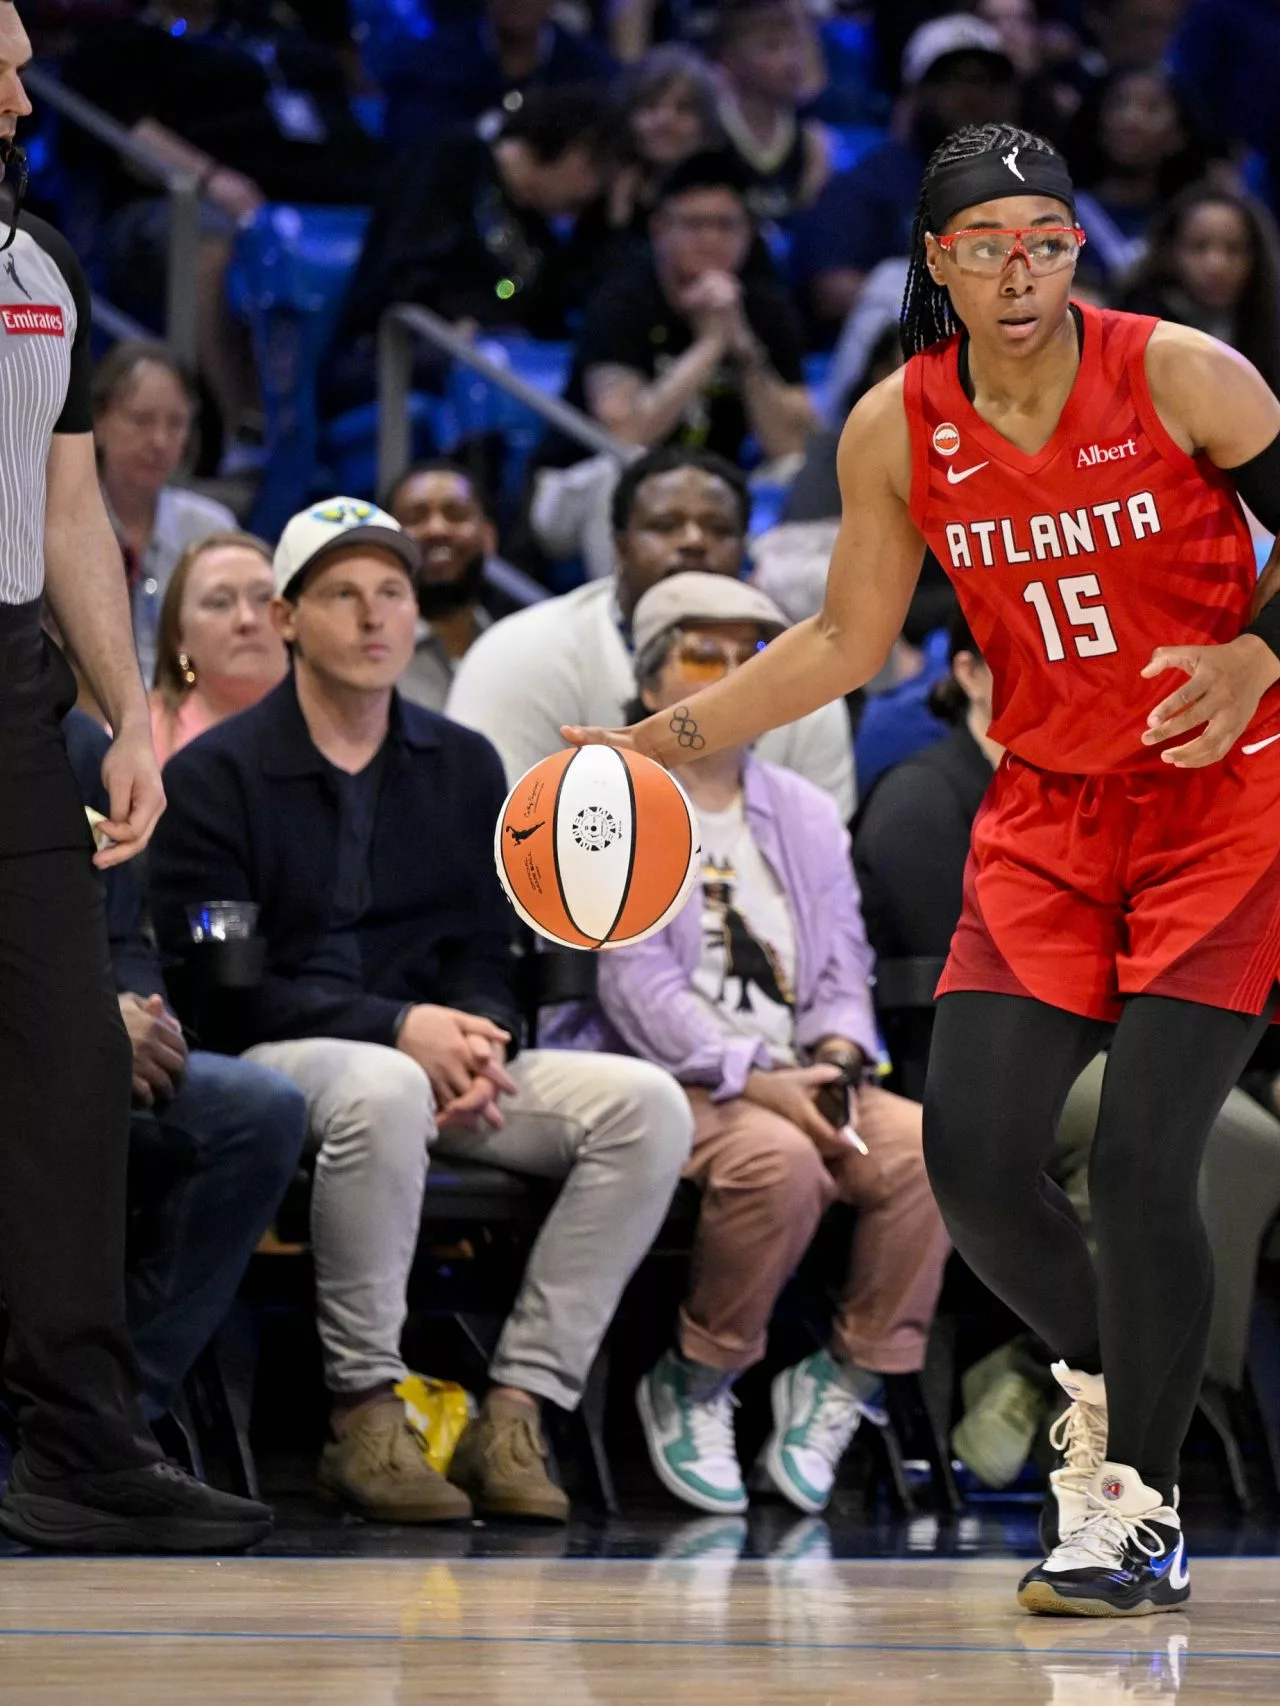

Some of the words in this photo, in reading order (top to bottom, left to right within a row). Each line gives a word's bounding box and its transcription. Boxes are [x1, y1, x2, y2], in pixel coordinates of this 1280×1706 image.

[2, 309, 63, 330] Emirates
[1077, 439, 1137, 468] Albert
[945, 490, 1161, 568] ATLANTA
[1023, 573, 1118, 662] 15
